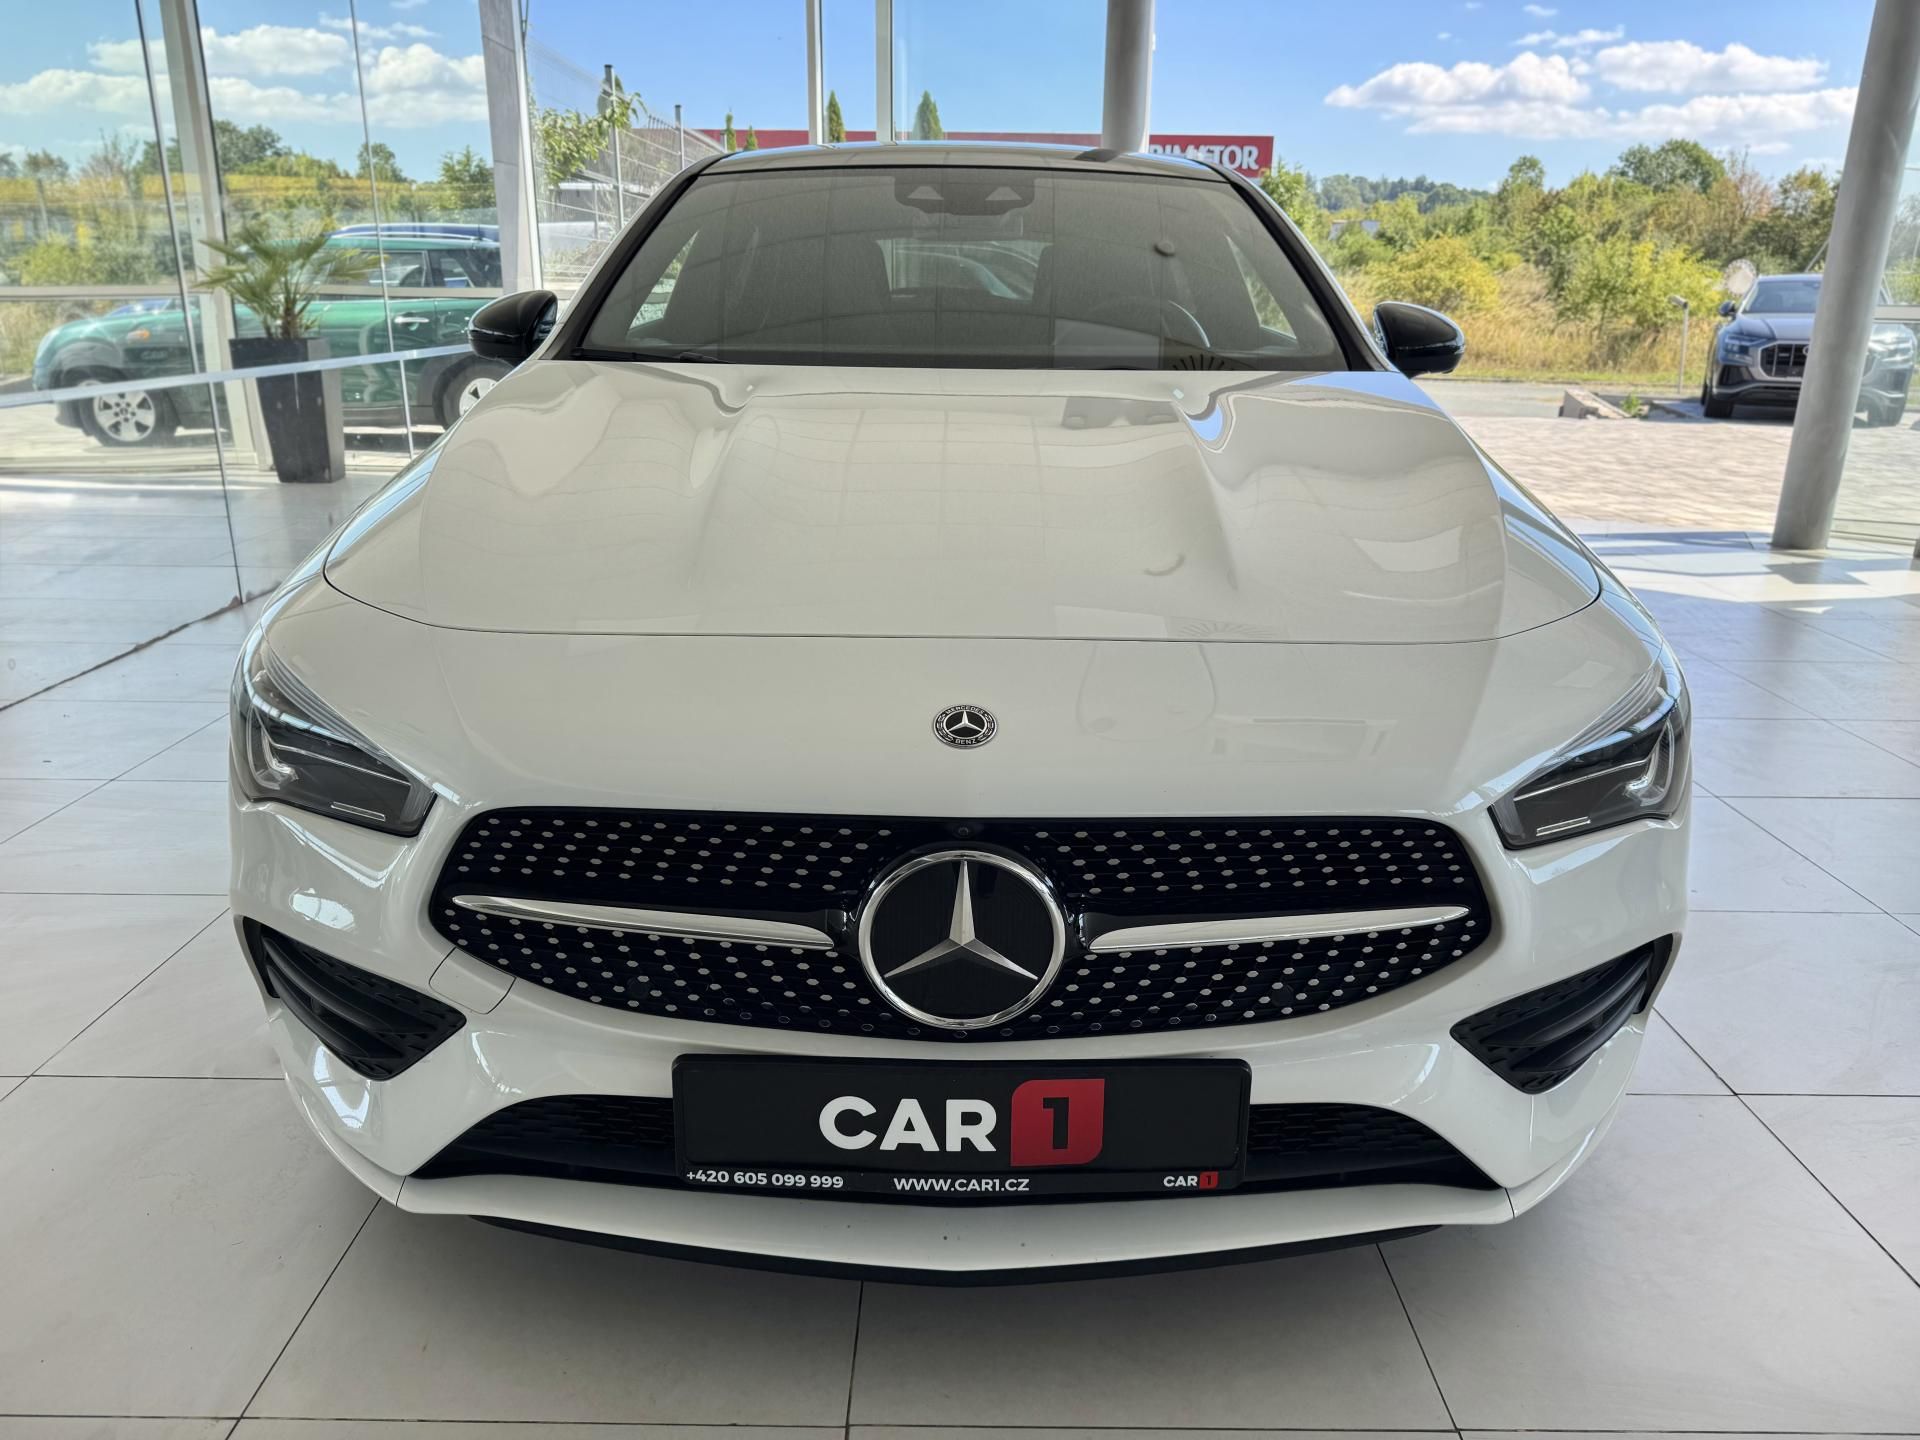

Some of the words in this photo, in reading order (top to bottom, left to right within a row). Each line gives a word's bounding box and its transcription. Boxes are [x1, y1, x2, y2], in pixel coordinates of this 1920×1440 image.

[686, 1169, 730, 1183] +420
[733, 1171, 768, 1185] 605
[771, 1173, 806, 1187] 099
[810, 1175, 844, 1189] 999
[893, 1177, 1030, 1192] WWW.CAR1.CZ
